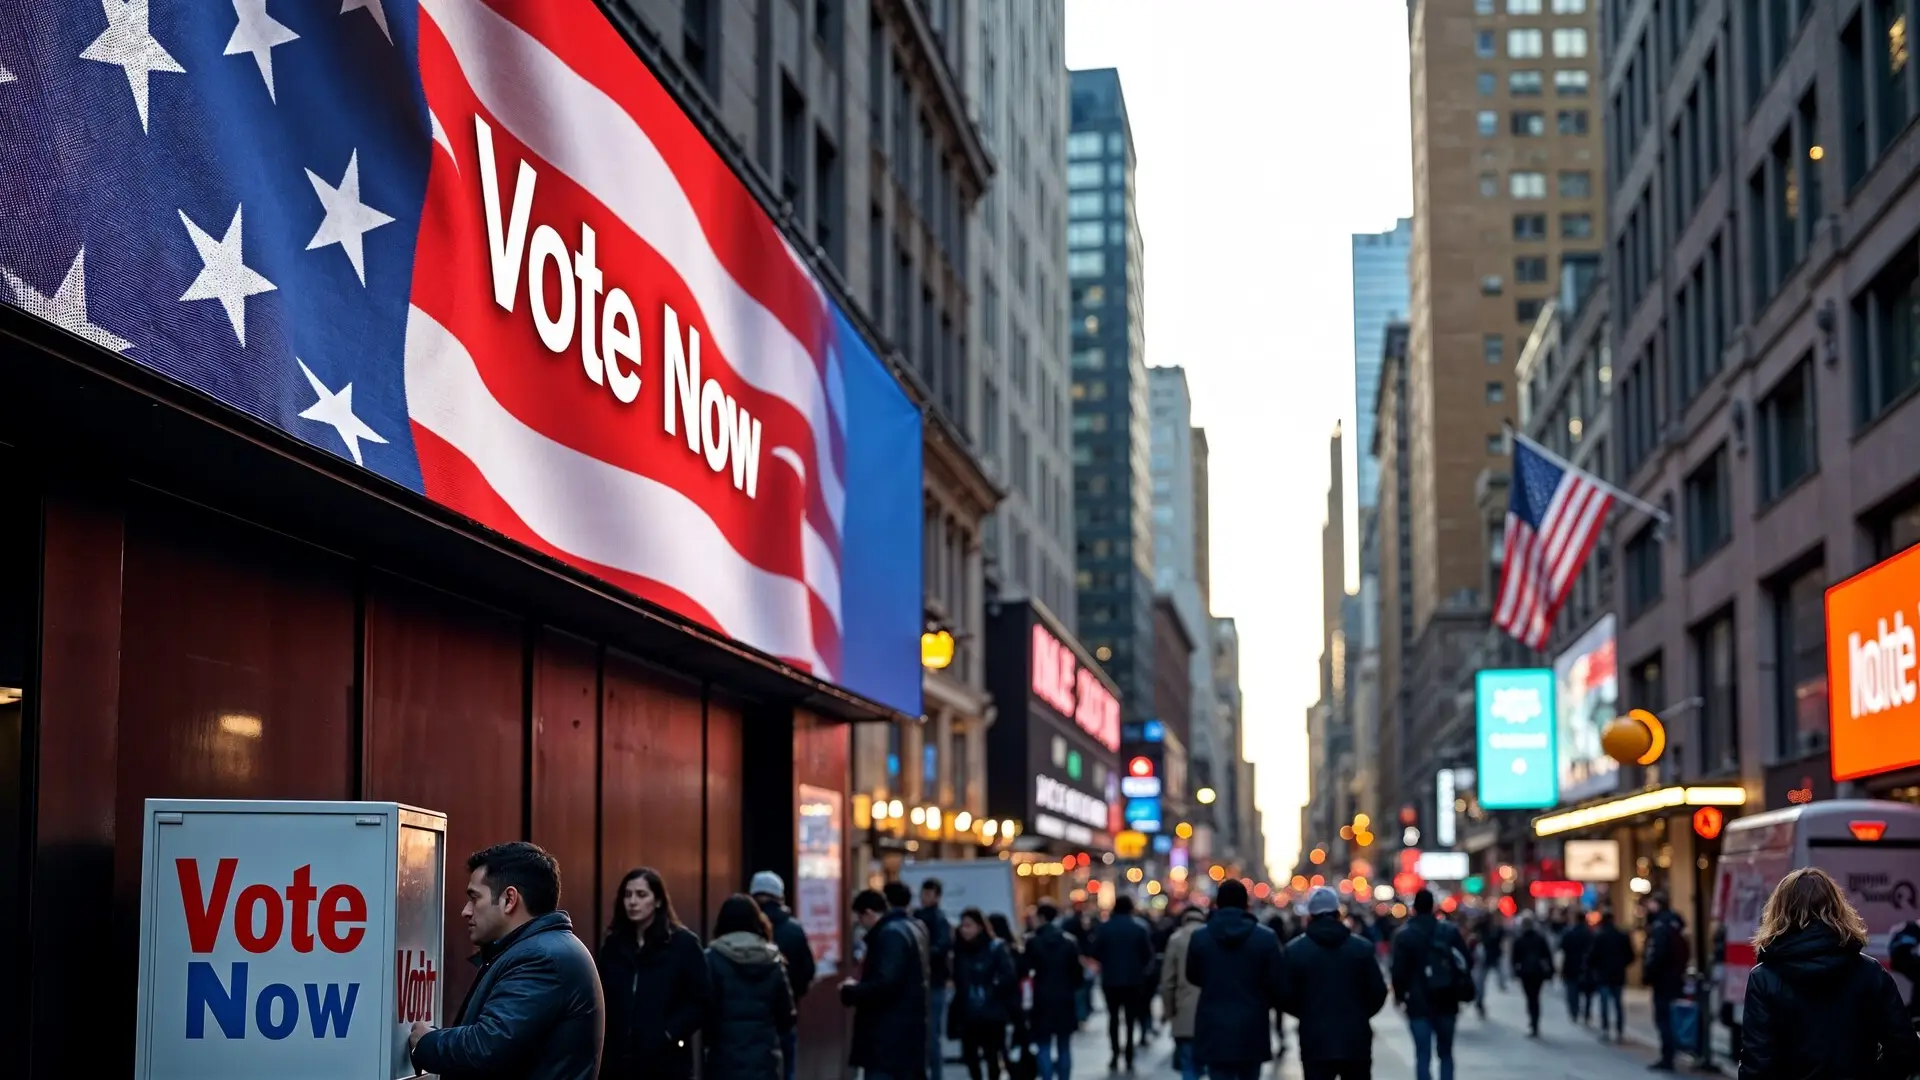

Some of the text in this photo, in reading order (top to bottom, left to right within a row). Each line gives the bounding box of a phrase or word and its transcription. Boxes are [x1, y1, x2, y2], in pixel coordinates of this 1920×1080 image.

[475, 113, 762, 498] Vote Now
[176, 858, 367, 953] Vote
[186, 962, 360, 1040] Now
